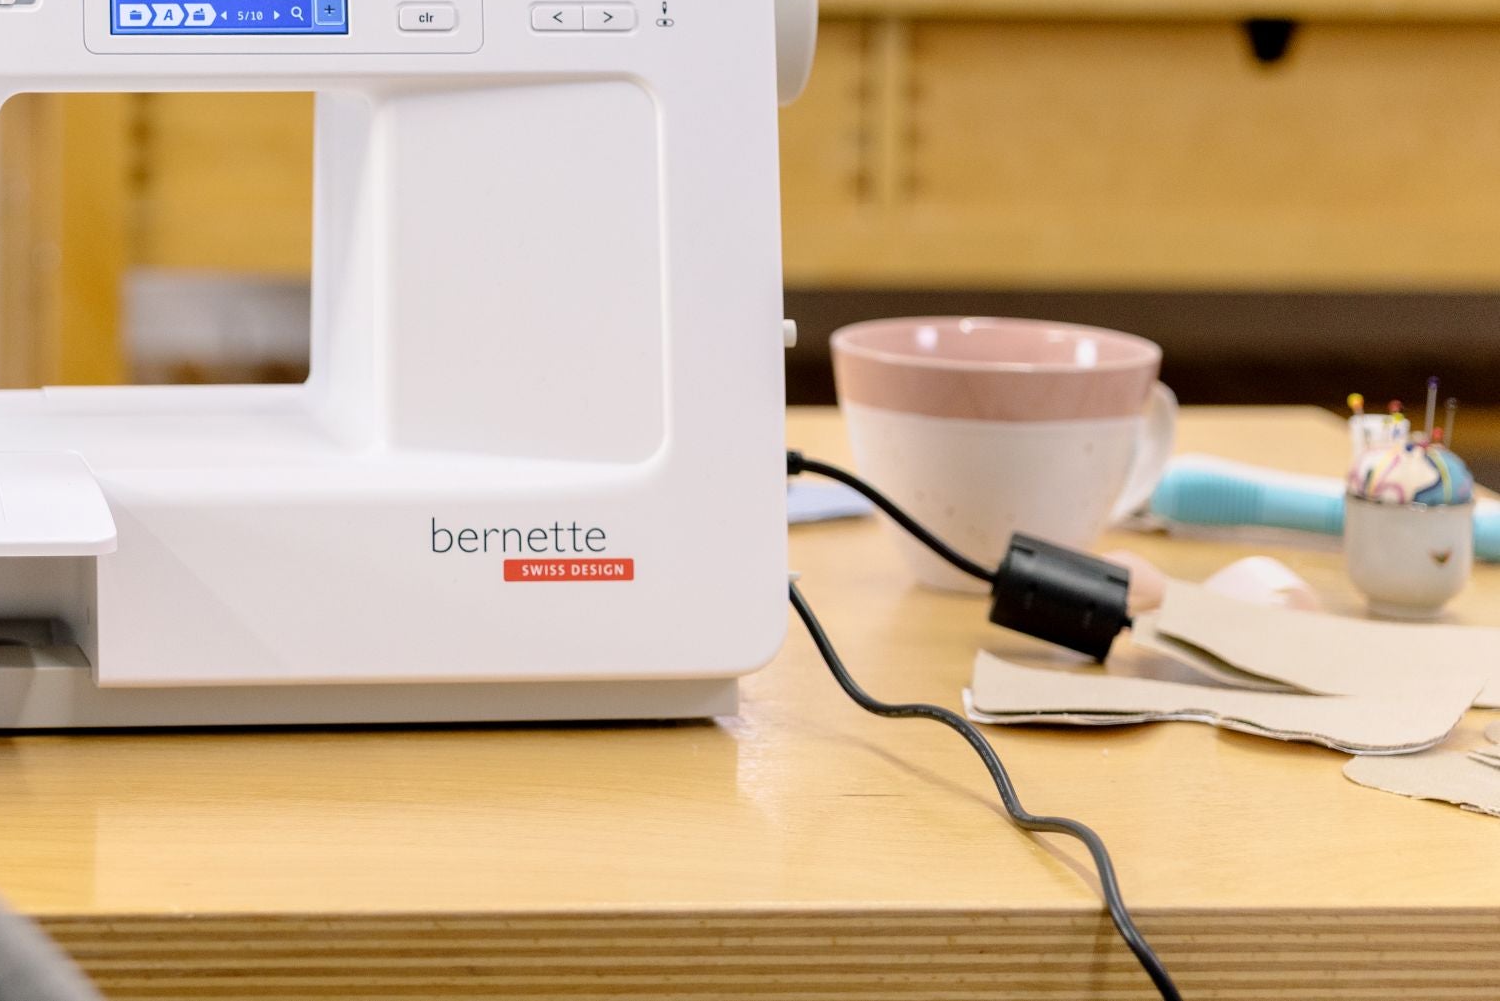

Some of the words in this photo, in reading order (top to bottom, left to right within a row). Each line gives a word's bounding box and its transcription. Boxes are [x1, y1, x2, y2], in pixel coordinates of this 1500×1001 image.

[163, 9, 174, 21] A
[237, 11, 264, 21] 5/10
[418, 12, 435, 24] clr
[431, 516, 606, 553] bernette
[521, 564, 566, 577] SWISS
[570, 563, 625, 576] DESIGN
